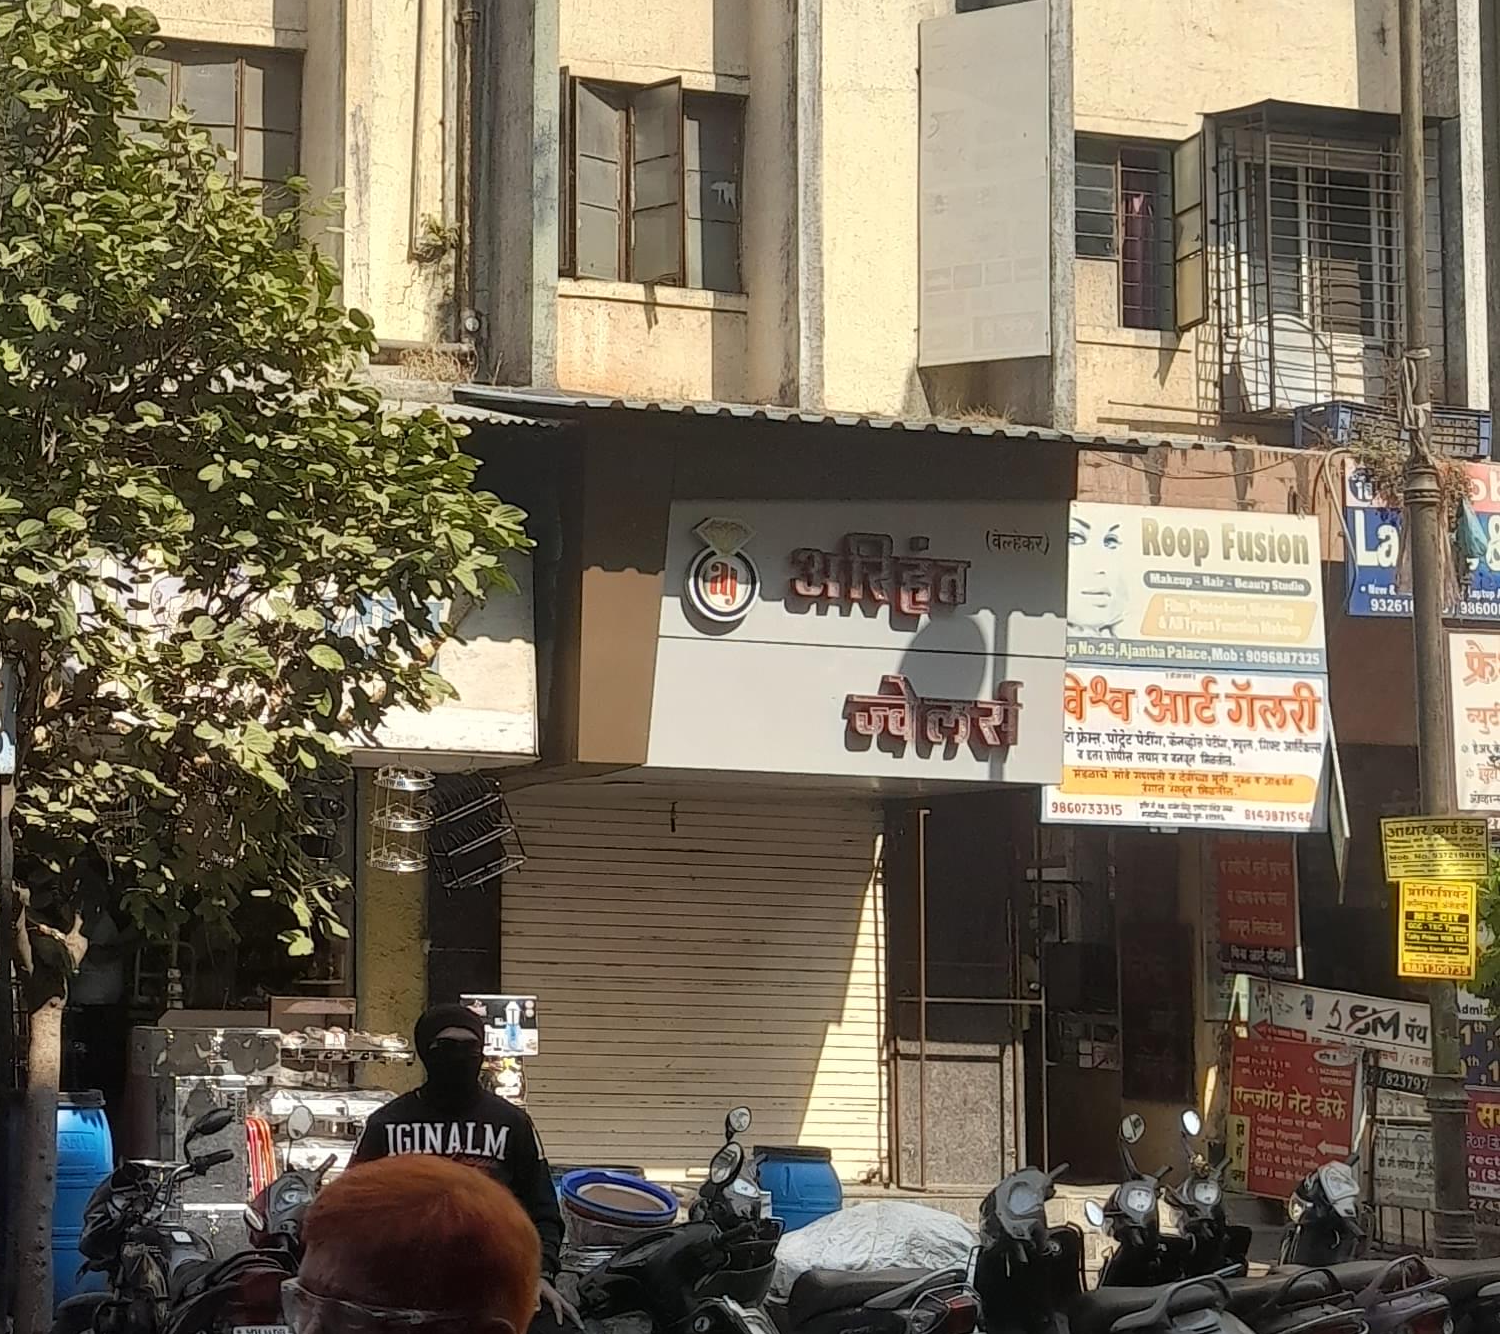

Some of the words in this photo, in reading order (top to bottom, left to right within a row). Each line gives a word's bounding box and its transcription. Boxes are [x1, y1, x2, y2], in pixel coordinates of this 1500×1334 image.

[1141, 517, 1210, 567] Roop
[1222, 522, 1309, 565] Fusion
[788, 532, 971, 615] अरिहंत
[1150, 573, 1193, 589] Makeup
[1202, 575, 1224, 588] Hair
[1234, 578, 1270, 592] Beauty
[1272, 579, 1305, 592] Studio
[1370, 598, 1414, 613] 93261
[1460, 601, 1500, 616] 98600
[1245, 651, 1320, 665] 9096887325
[1144, 676, 1219, 725] आर्ट
[1225, 678, 1322, 733] गॅलरी
[1051, 801, 1123, 816] 9860733315
[1386, 824, 1428, 838] आधार
[1385, 1071, 1429, 1092] 823797
[1233, 1082, 1284, 1111] एन्जॉय
[1287, 1086, 1312, 1116] नेट
[1315, 1087, 1347, 1120] कॅफे
